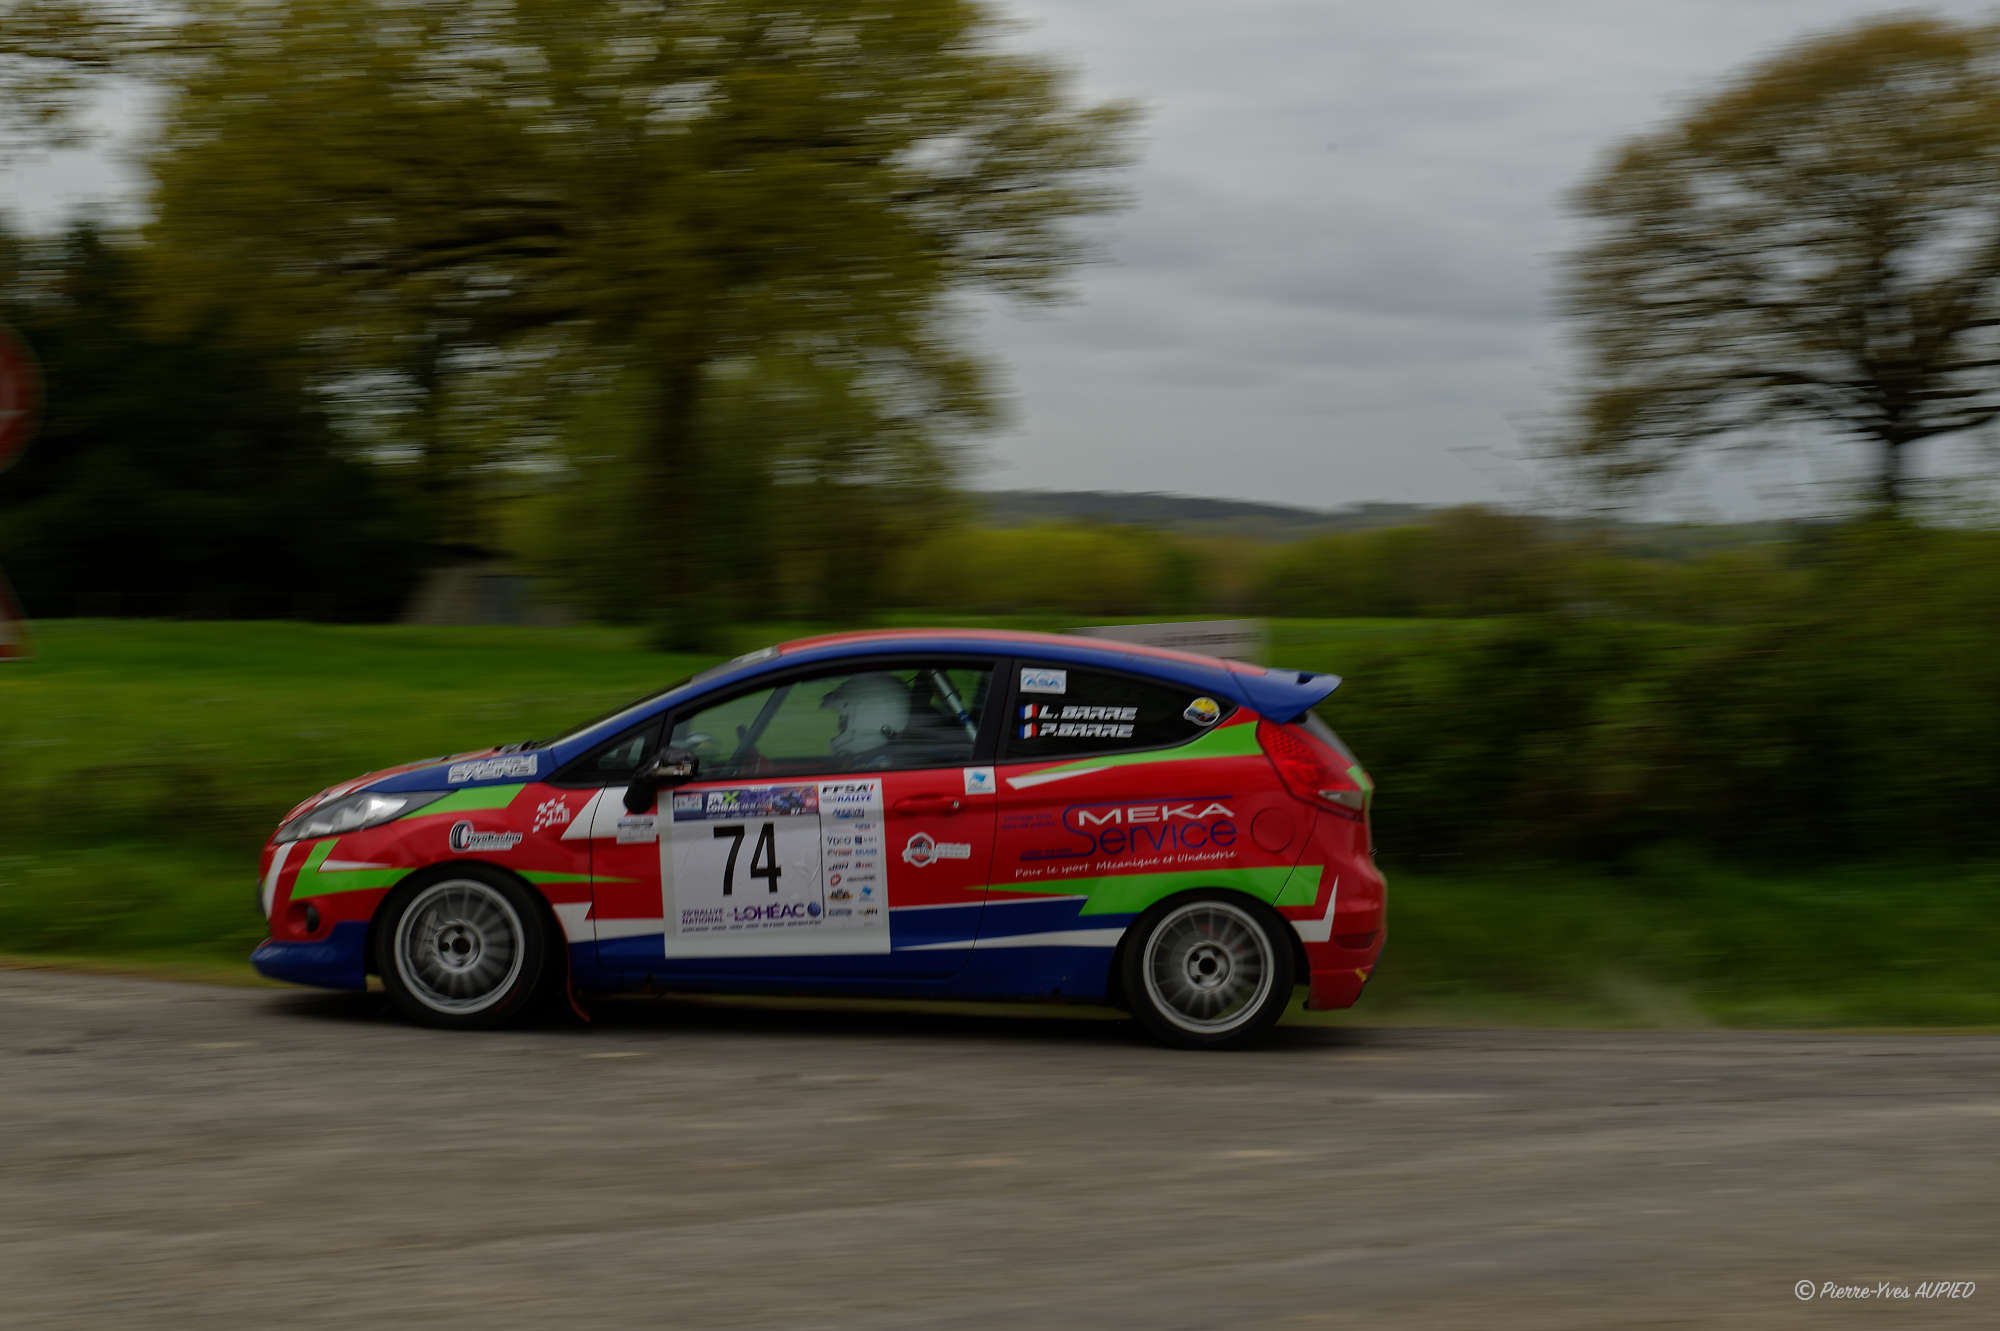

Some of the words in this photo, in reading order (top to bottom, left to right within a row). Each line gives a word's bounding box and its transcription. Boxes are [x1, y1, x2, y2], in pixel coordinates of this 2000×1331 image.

[1061, 705, 1138, 720] BARRE
[1078, 802, 1235, 827] MEKA
[1063, 806, 1237, 855] Service
[713, 822, 782, 896] 74
[1015, 867, 1042, 878] Pour
[1061, 861, 1089, 874] sport
[1163, 855, 1174, 864] et
[734, 902, 805, 922] LOHÉAC
